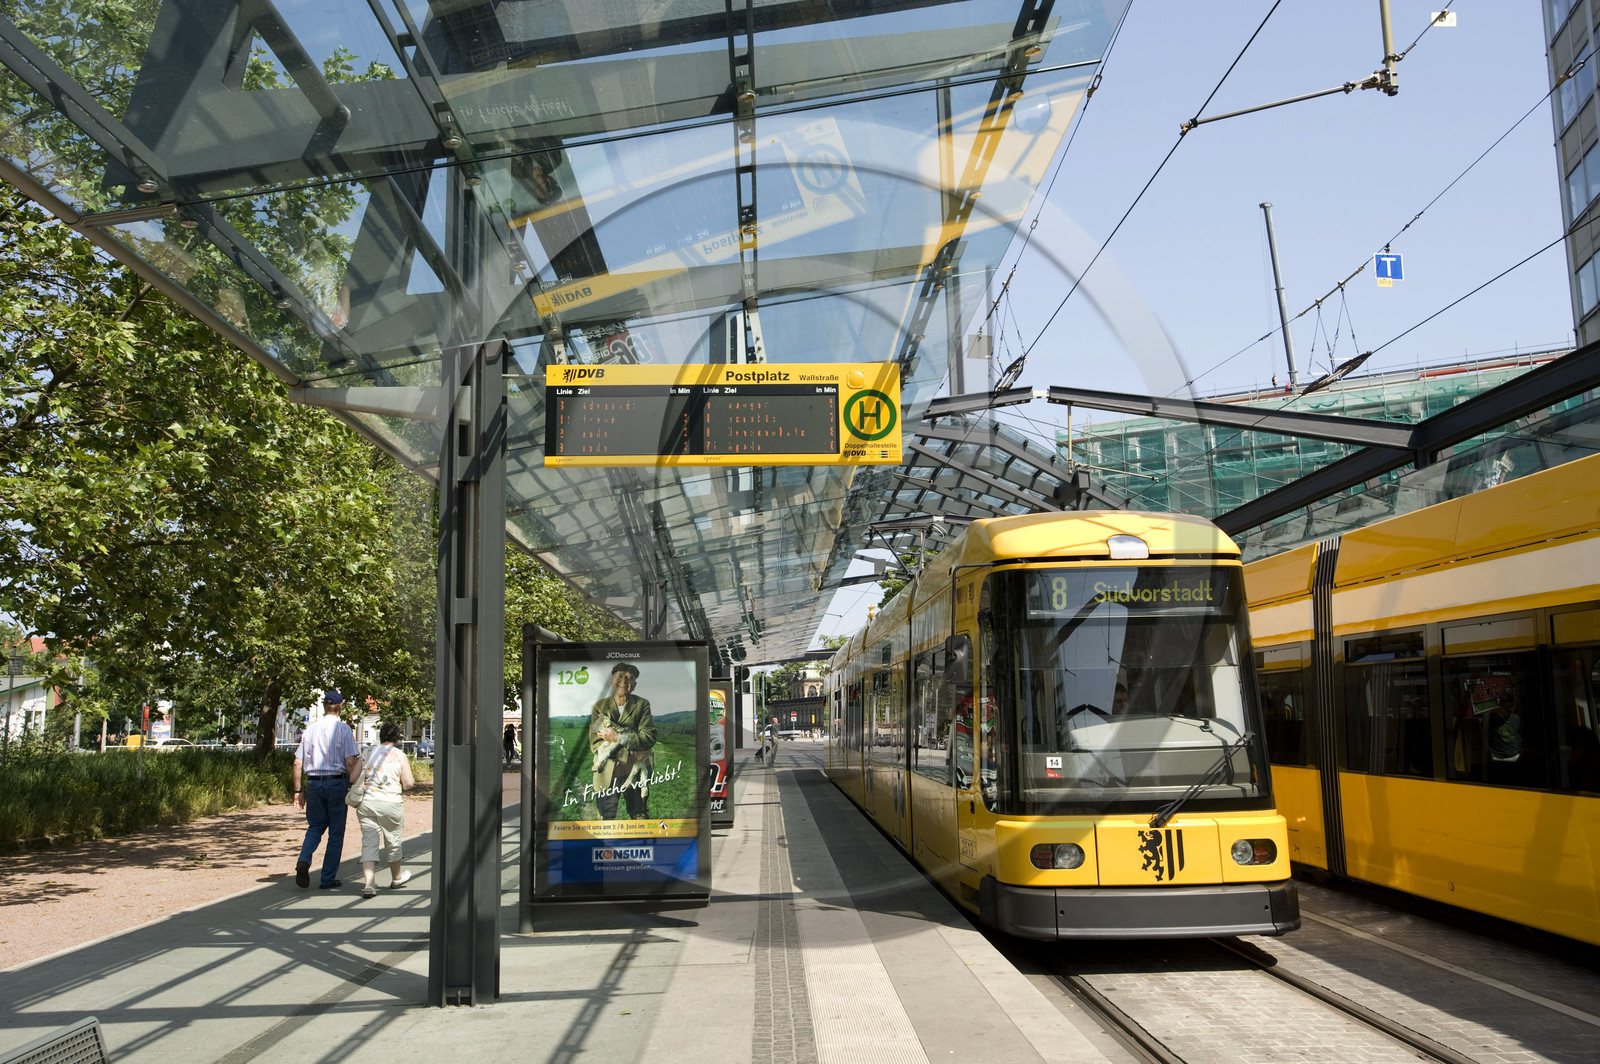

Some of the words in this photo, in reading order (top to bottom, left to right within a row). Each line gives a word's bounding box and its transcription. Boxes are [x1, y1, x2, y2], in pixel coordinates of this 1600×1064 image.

[1380, 257, 1396, 276] T
[577, 368, 605, 378] DVB
[726, 371, 790, 383] Postplatz
[859, 401, 881, 430] H
[1052, 577, 1067, 610] 8
[1094, 580, 1213, 602] Südvorstadt
[563, 788, 579, 807] In
[583, 778, 626, 802] Frische
[632, 760, 682, 790] verliebt!
[594, 848, 651, 860] KONSUM
